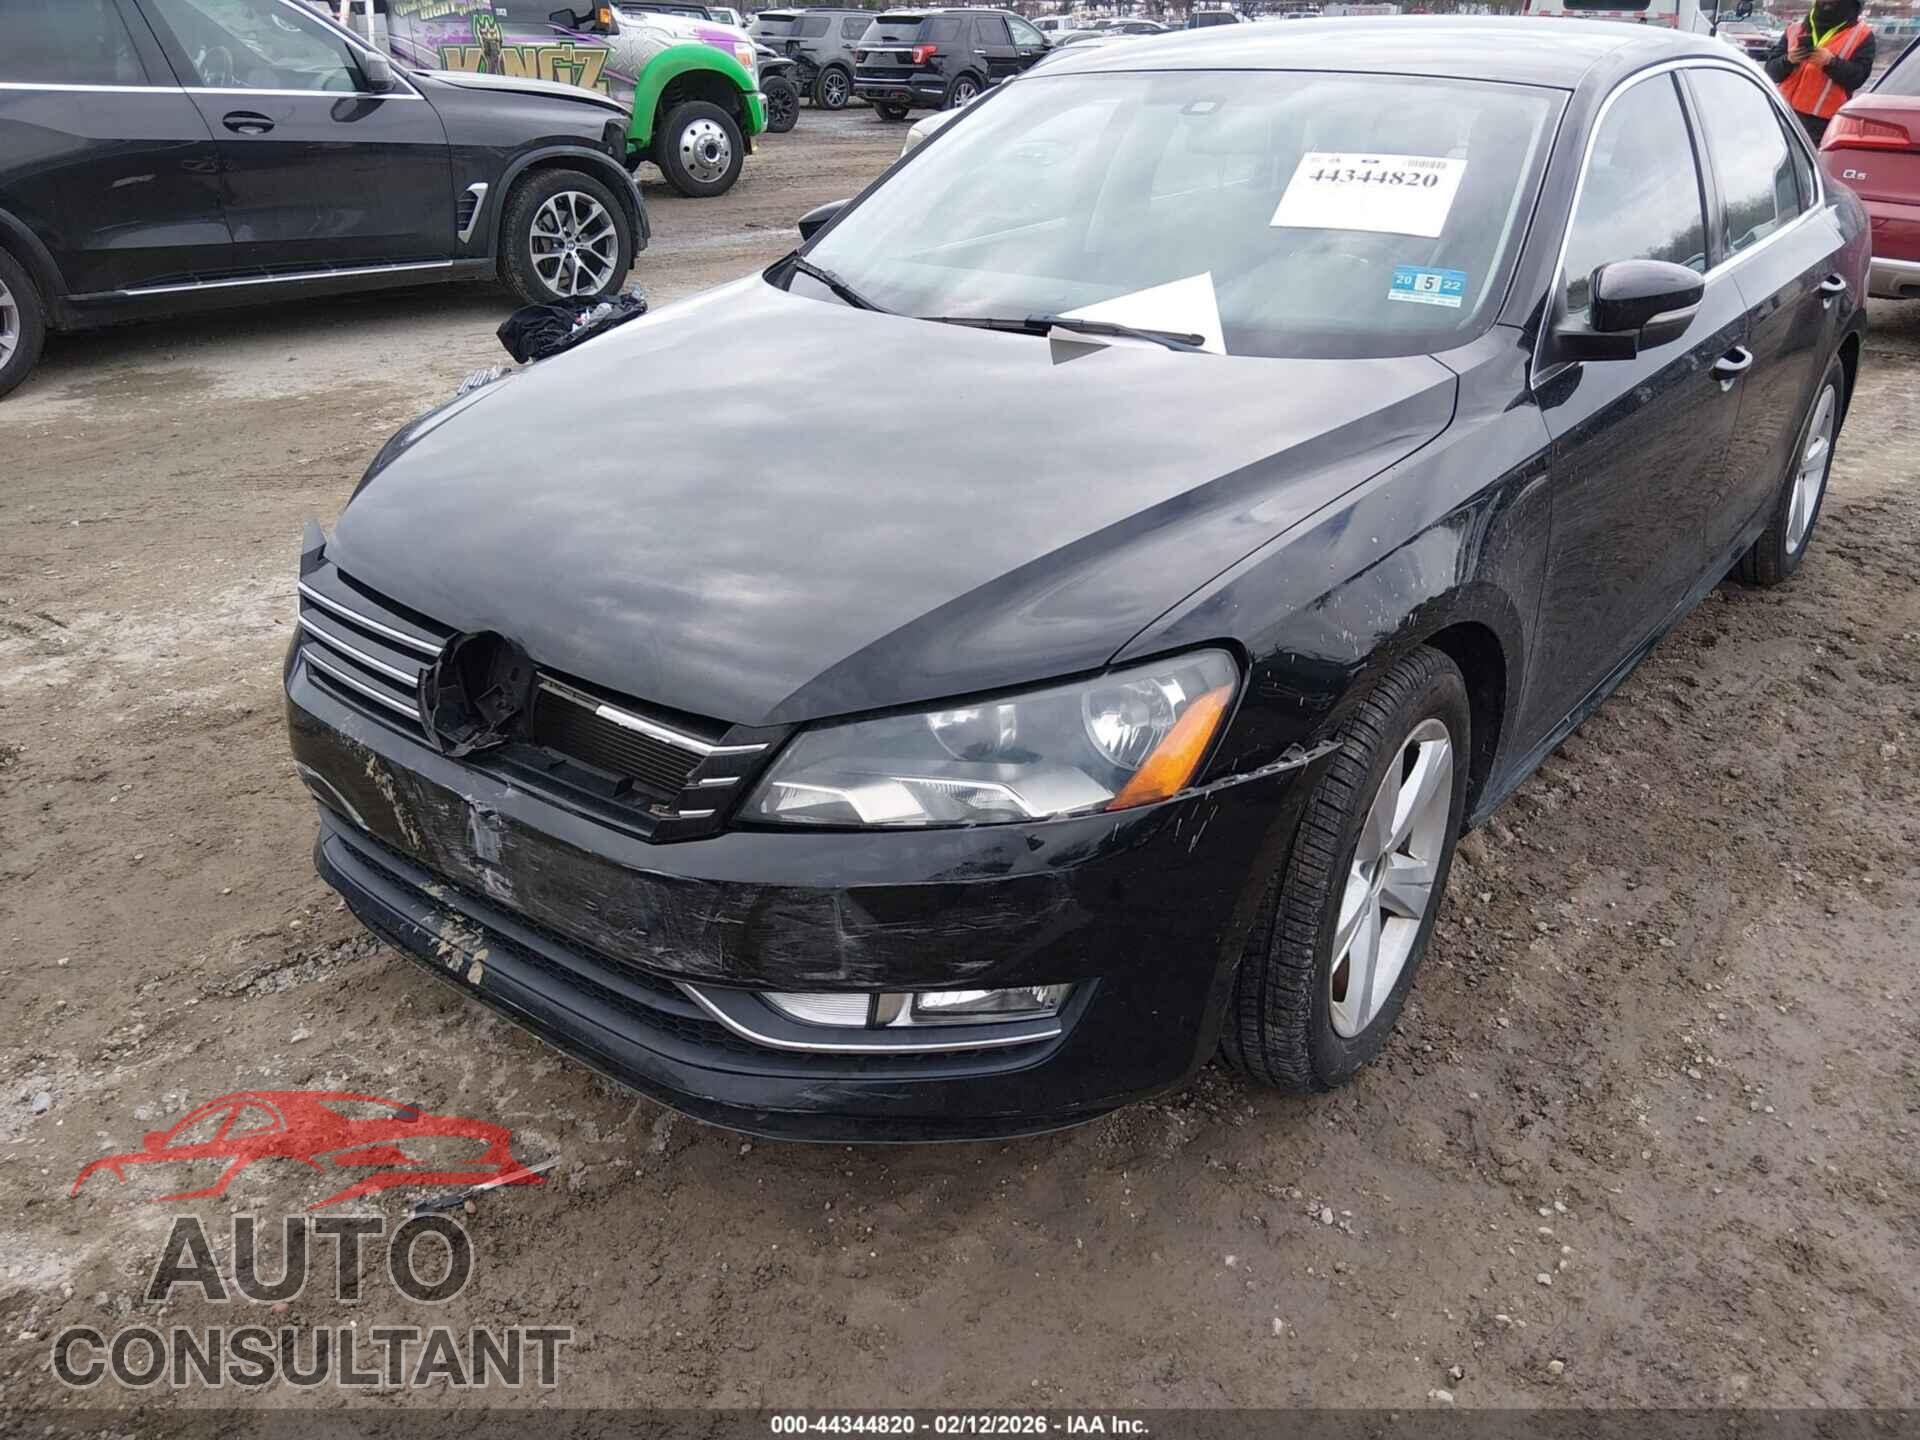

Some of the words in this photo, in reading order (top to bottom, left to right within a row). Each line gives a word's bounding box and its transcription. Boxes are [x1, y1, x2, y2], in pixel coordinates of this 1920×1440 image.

[1309, 168, 1439, 188] 44344820
[1842, 169, 1867, 180] Q5
[1396, 275, 1413, 285] 20
[1424, 277, 1435, 290] 5
[1443, 280, 1461, 290] 22
